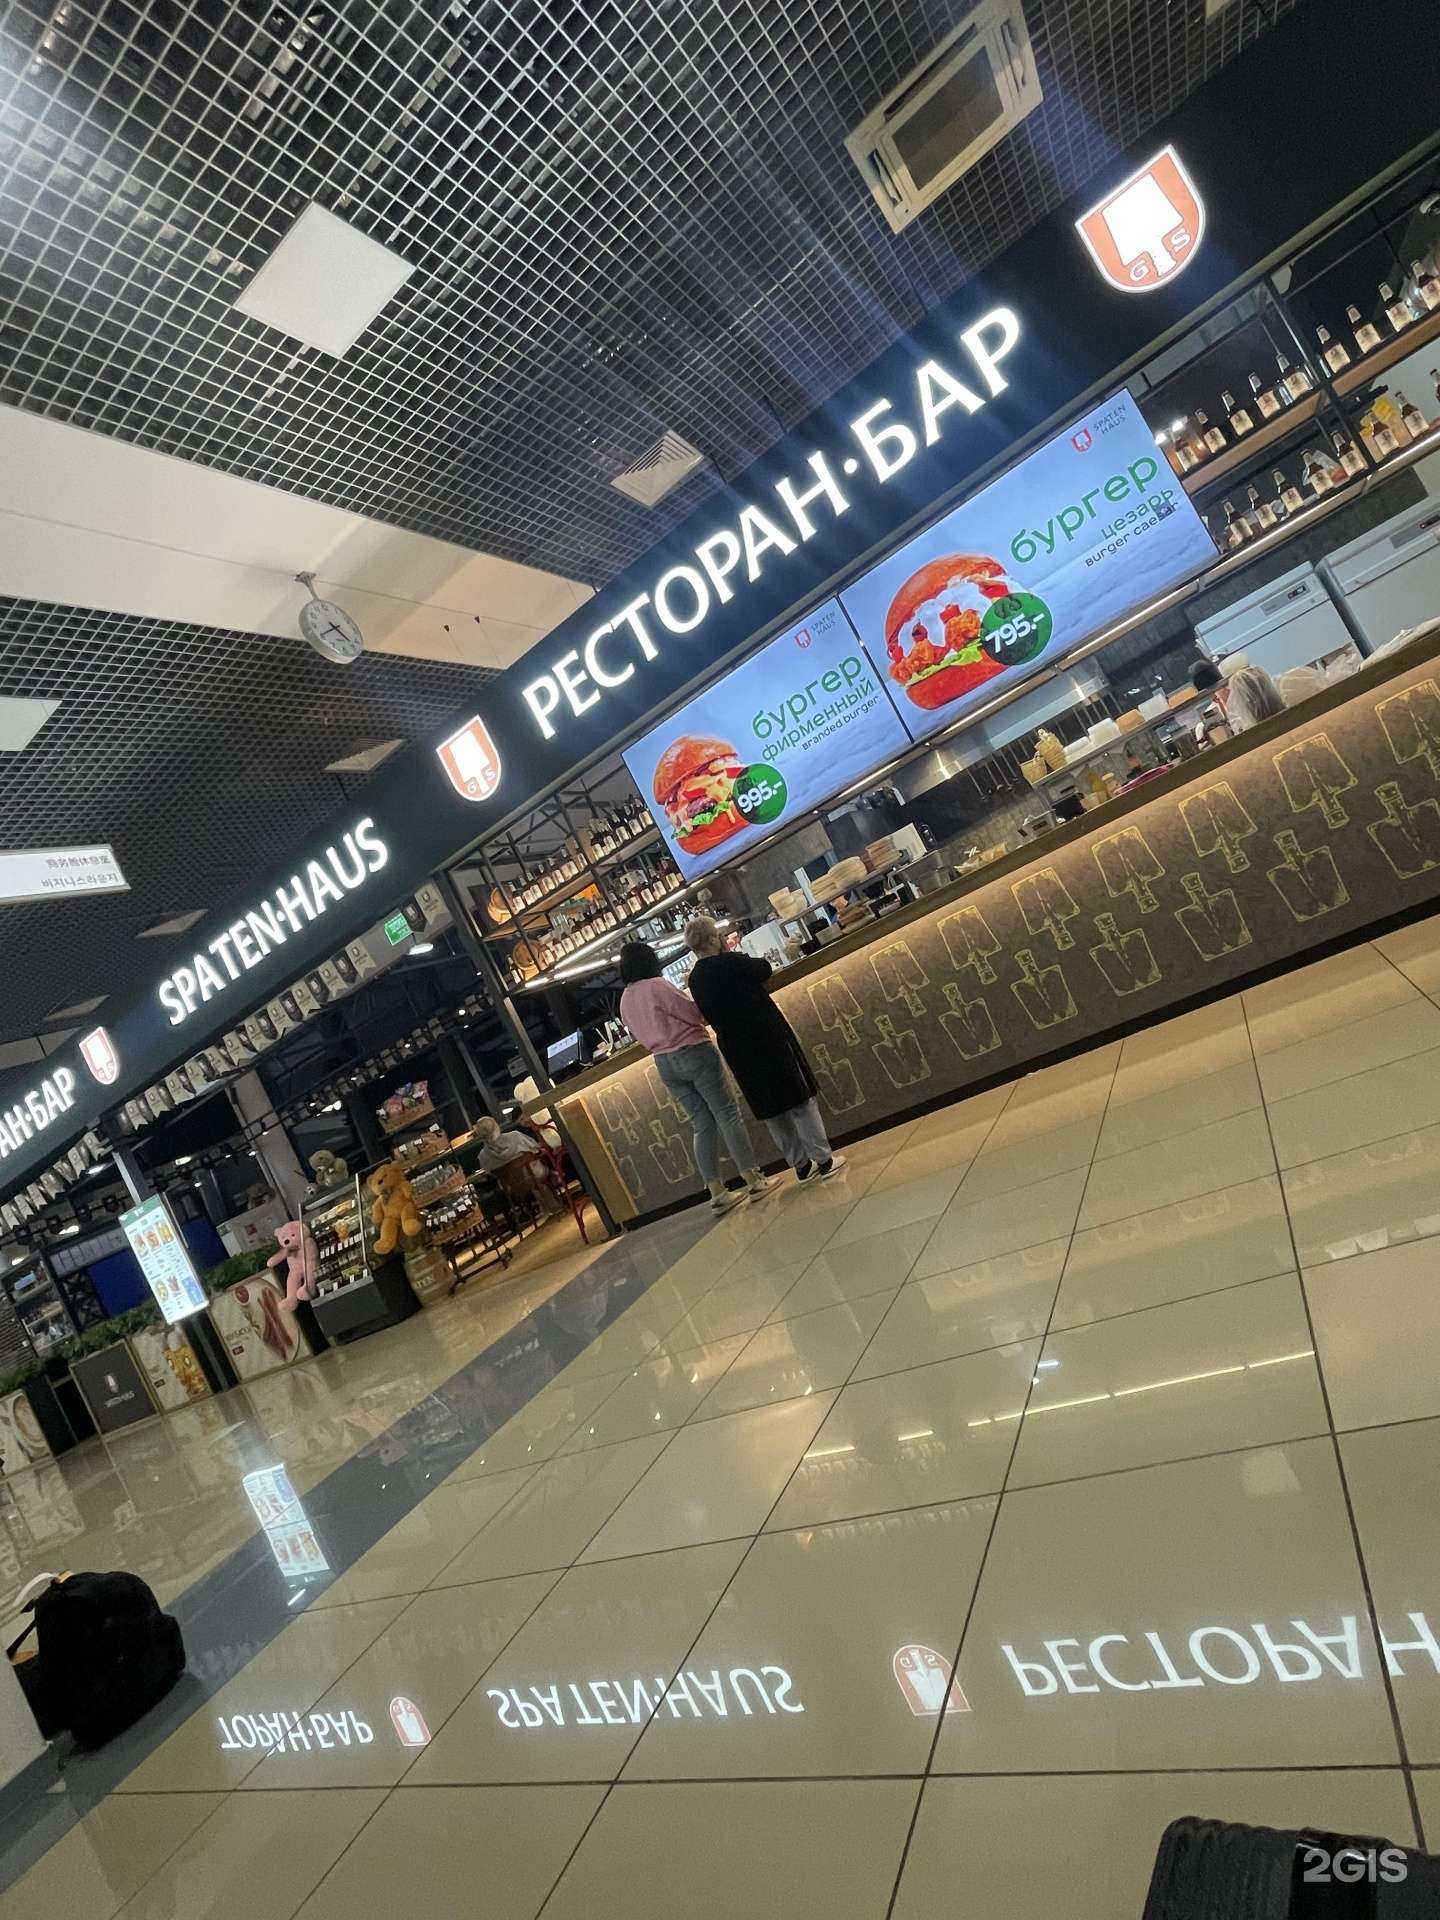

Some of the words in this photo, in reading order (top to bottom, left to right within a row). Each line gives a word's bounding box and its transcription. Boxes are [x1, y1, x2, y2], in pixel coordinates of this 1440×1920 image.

[1093, 405, 1126, 432] SPATEN
[1101, 414, 1126, 435] HAUS
[1010, 456, 1158, 563] бургер
[1101, 489, 1174, 540] цезарь
[1133, 502, 1179, 536] caesar
[752, 656, 862, 739] бургер
[761, 677, 875, 762] фирменный
